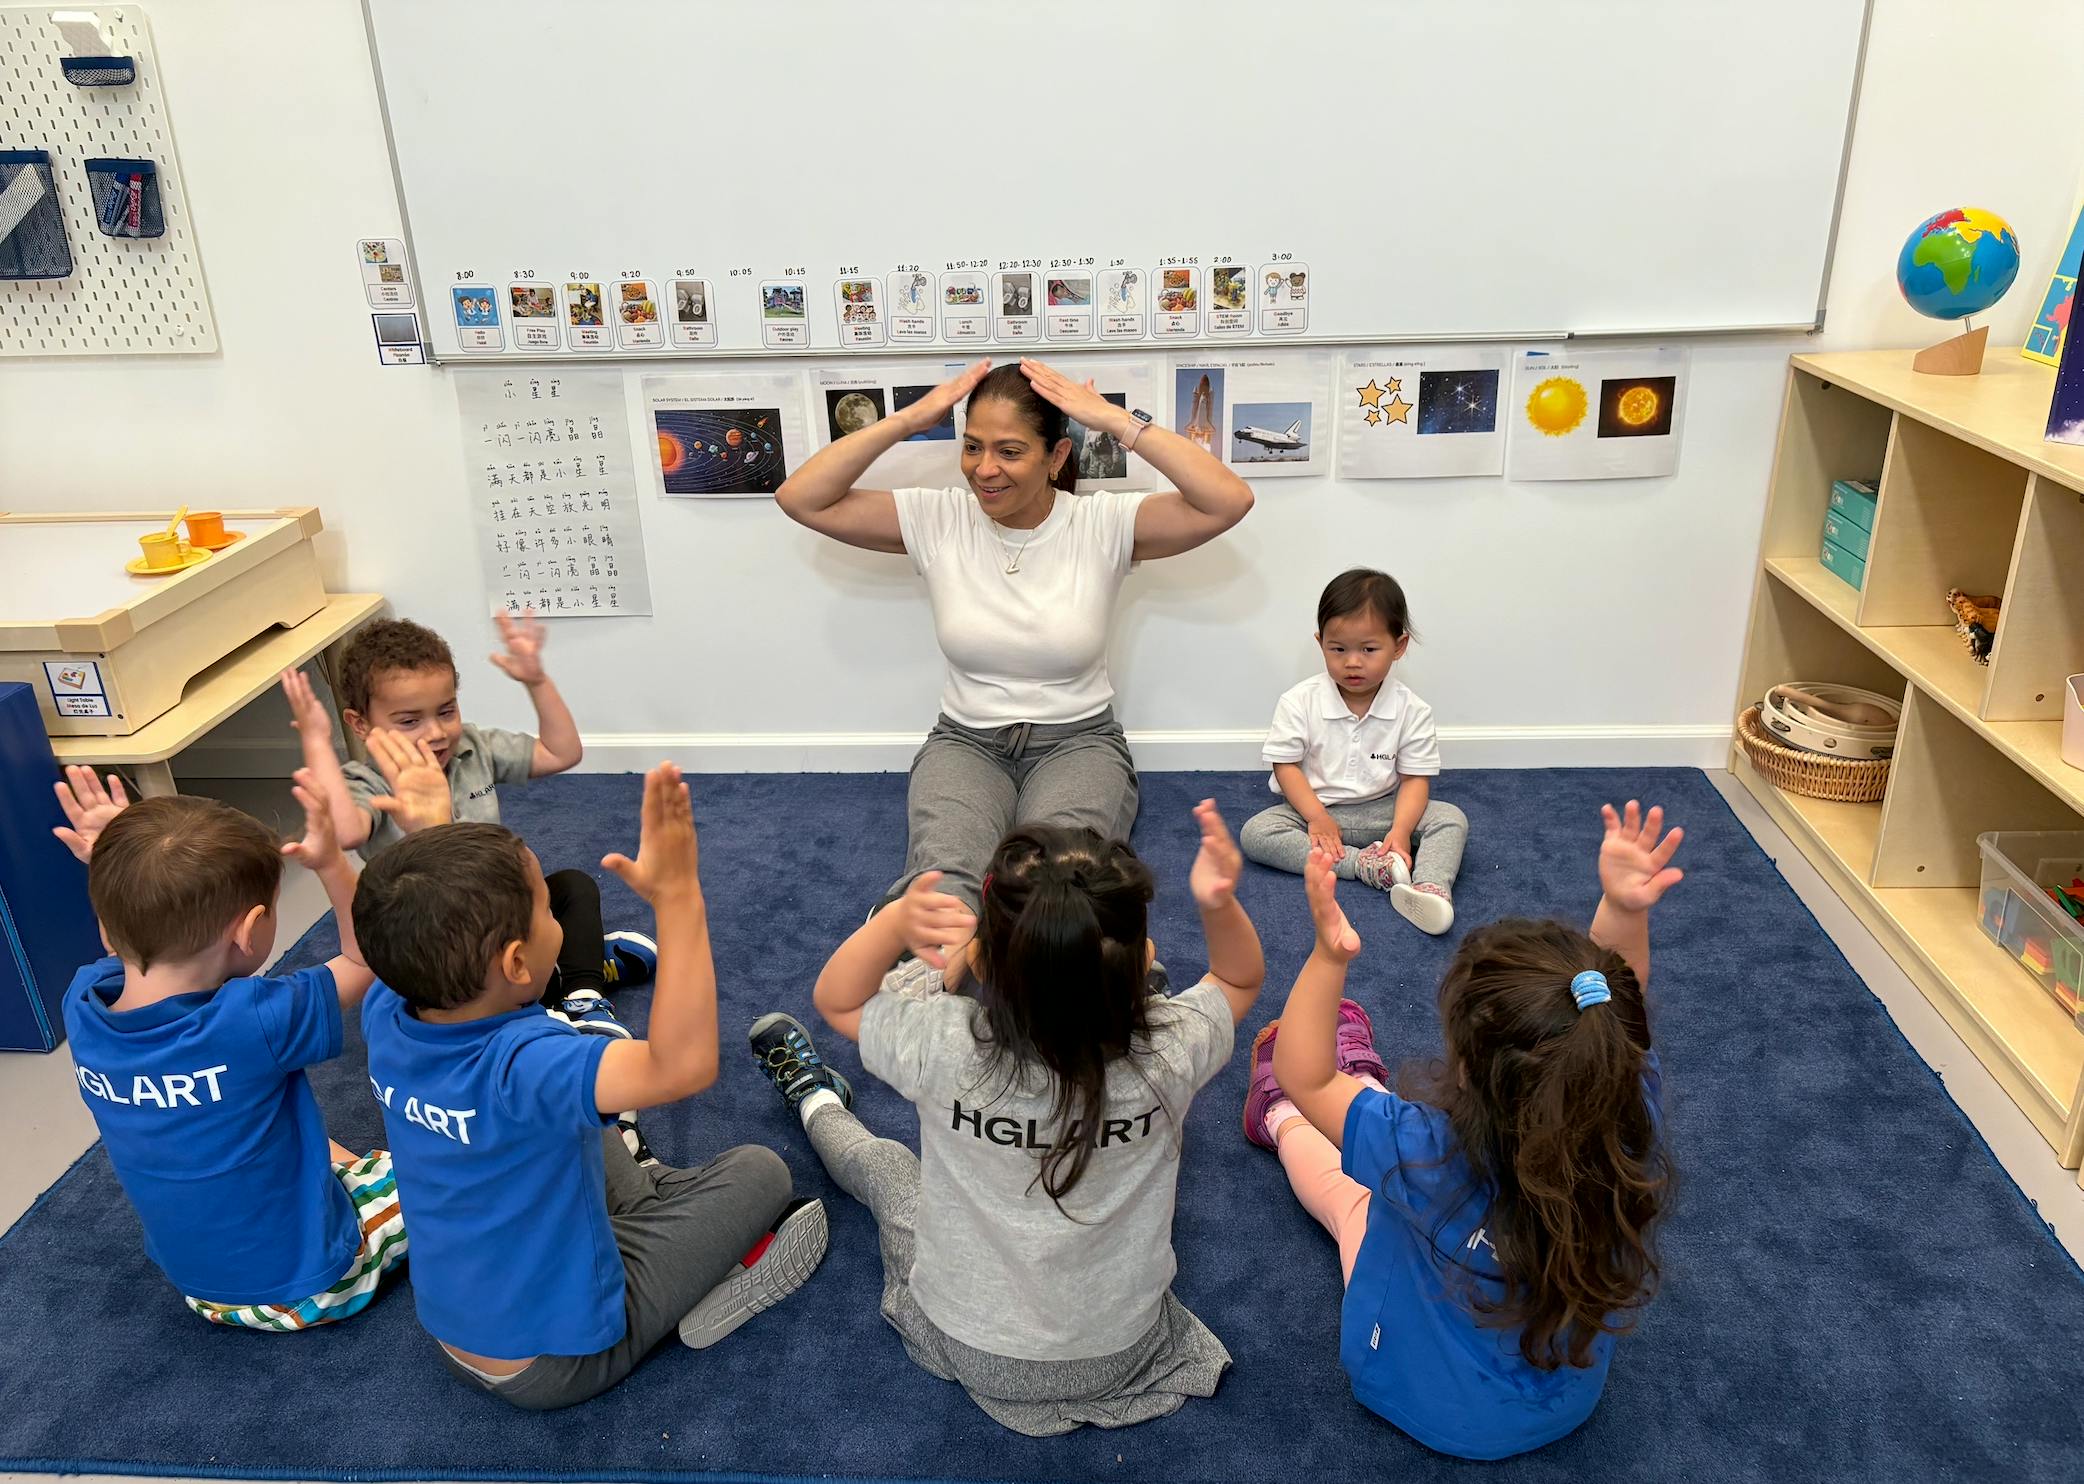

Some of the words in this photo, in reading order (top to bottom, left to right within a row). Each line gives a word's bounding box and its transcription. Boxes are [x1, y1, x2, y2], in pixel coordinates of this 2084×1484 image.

[1272, 253, 1293, 261] 3:00
[1110, 258, 1124, 267] 1:30
[730, 268, 752, 277] 10:05
[784, 267, 806, 276] 10:15
[897, 264, 920, 272] 11:20
[456, 270, 474, 280] 8:00
[513, 269, 535, 279] 8:30
[570, 272, 590, 281] 9:00
[621, 270, 641, 279] 9:20
[676, 268, 695, 278] 9:50
